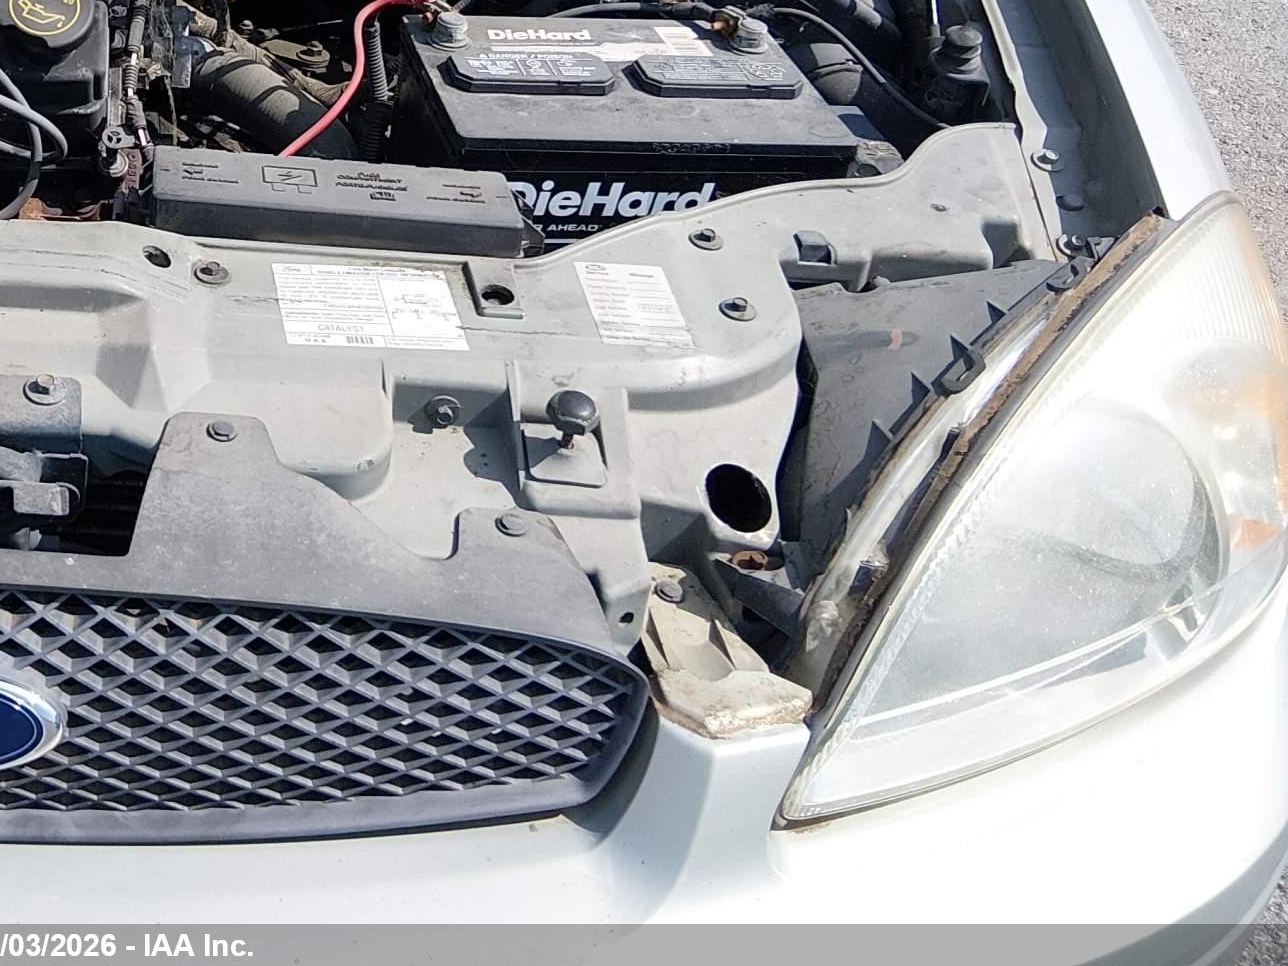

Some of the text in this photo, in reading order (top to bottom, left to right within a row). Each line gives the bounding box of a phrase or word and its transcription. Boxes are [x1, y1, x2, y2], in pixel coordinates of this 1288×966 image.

[487, 29, 592, 40] DieHard
[546, 224, 599, 232] AHEAD
[318, 323, 365, 333] CATALYST
